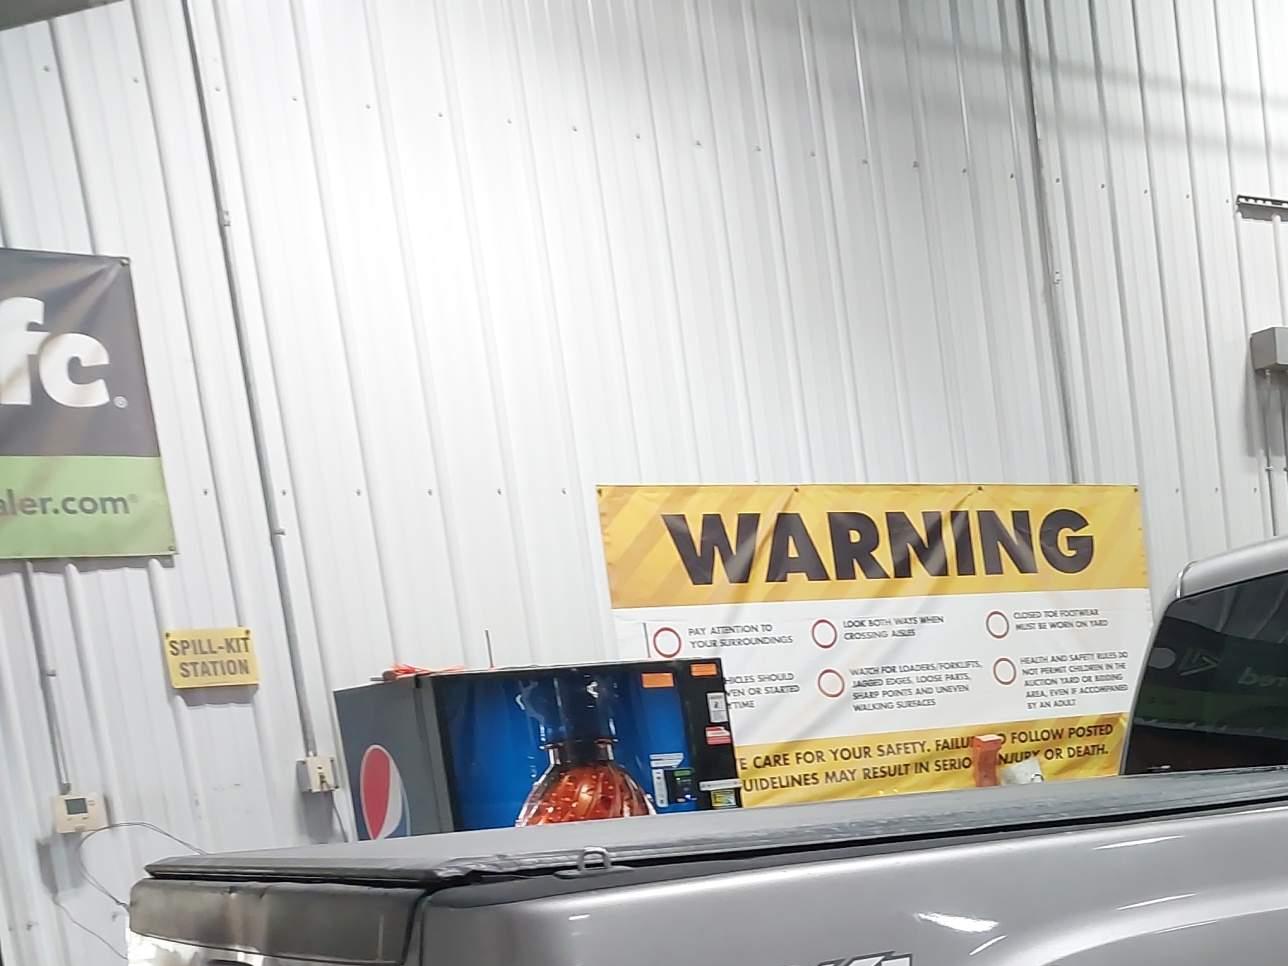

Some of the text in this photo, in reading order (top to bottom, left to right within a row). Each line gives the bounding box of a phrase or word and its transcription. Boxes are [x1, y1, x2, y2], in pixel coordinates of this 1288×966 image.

[661, 508, 1095, 586] WARNING
[1013, 610, 1041, 620] CLOSED
[1059, 608, 1099, 618] FOOTWEAR
[843, 615, 944, 629] LOOK BOTH WAYS WHEN
[1015, 619, 1109, 631] MUST BE WORN ON YARD
[688, 623, 773, 636] PAY ATTENTION TO
[844, 629, 916, 641] CROSSING AISLES
[169, 637, 250, 656] SPILL-KIT
[690, 636, 793, 649] YOUR SURROUNDINGS
[1020, 650, 1129, 665] HEALTH AND SAFETY RULES DO
[180, 659, 250, 678] STATION
[850, 666, 880, 676] WATCH
[881, 665, 897, 674] FOR
[1022, 662, 1127, 676] NOT PERMIT CHILDREN IN THE
[757, 672, 794, 683] SHOULD
[852, 678, 884, 688] JAGGED
[916, 674, 944, 684] LOOSE
[1024, 673, 1123, 687] AUCTION YARD OR BIDDING
[749, 685, 762, 695] OR
[764, 684, 800, 695] STARTED
[852, 685, 970, 701] SHARP POINTS AND UNEVEN
[1049, 688, 1070, 697] EVEN
[1070, 687, 1078, 695] IF
[1079, 684, 1129, 694] ACCOMPANIED
[852, 698, 937, 712] WALKING SURFACES
[1027, 699, 1077, 710] BY AN ADULT
[753, 753, 791, 770] CARE
[795, 751, 826, 766] FOR
[828, 746, 873, 763] YOUR
[876, 740, 931, 757] SAFETY.
[1011, 728, 1065, 744] FOLLOW
[1068, 723, 1113, 738] POSTED
[824, 768, 857, 785] MAY
[863, 763, 910, 780] RESULT
[914, 761, 930, 774] IN
[934, 757, 972, 772] SERIO
[1043, 748, 1063, 761] OR
[1067, 744, 1109, 758] DEATH.
